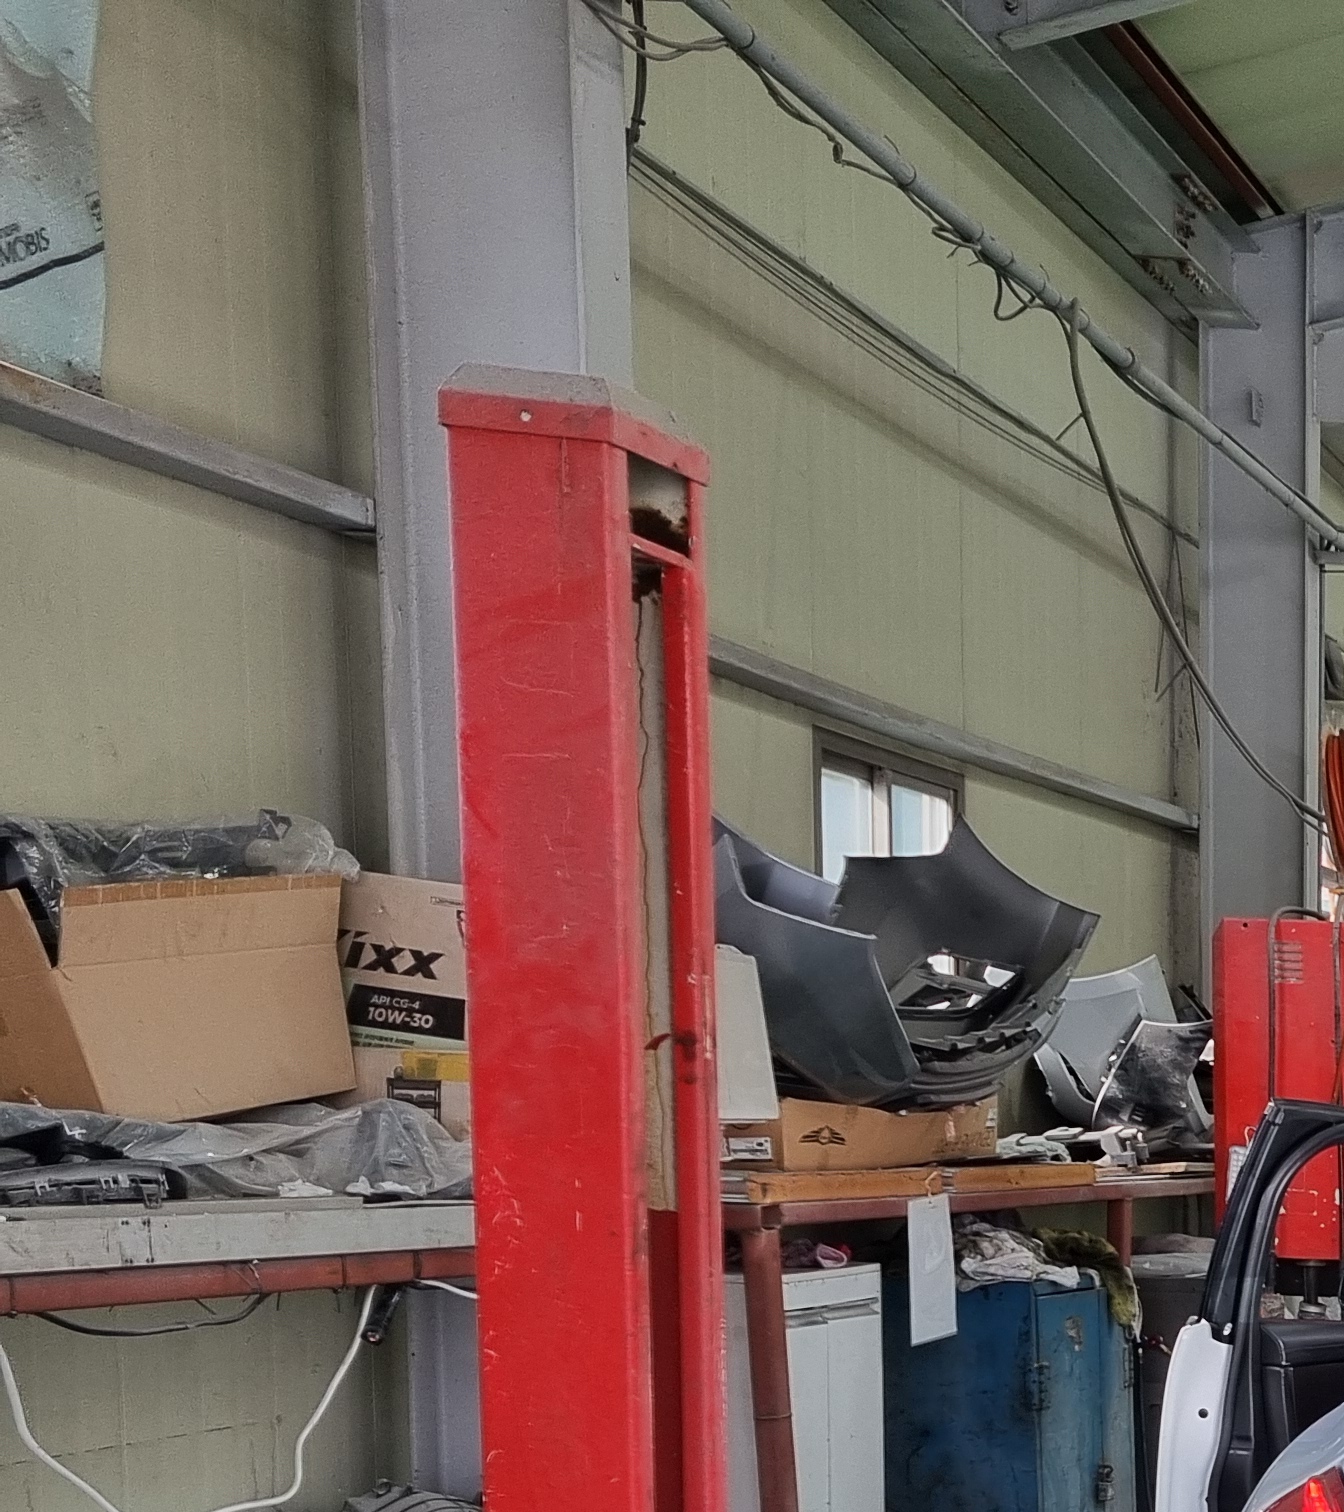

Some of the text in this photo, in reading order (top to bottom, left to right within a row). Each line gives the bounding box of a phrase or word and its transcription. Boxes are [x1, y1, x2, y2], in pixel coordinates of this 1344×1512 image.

[370, 994, 421, 1010] API CG-4
[367, 1006, 434, 1030] 10W-30
